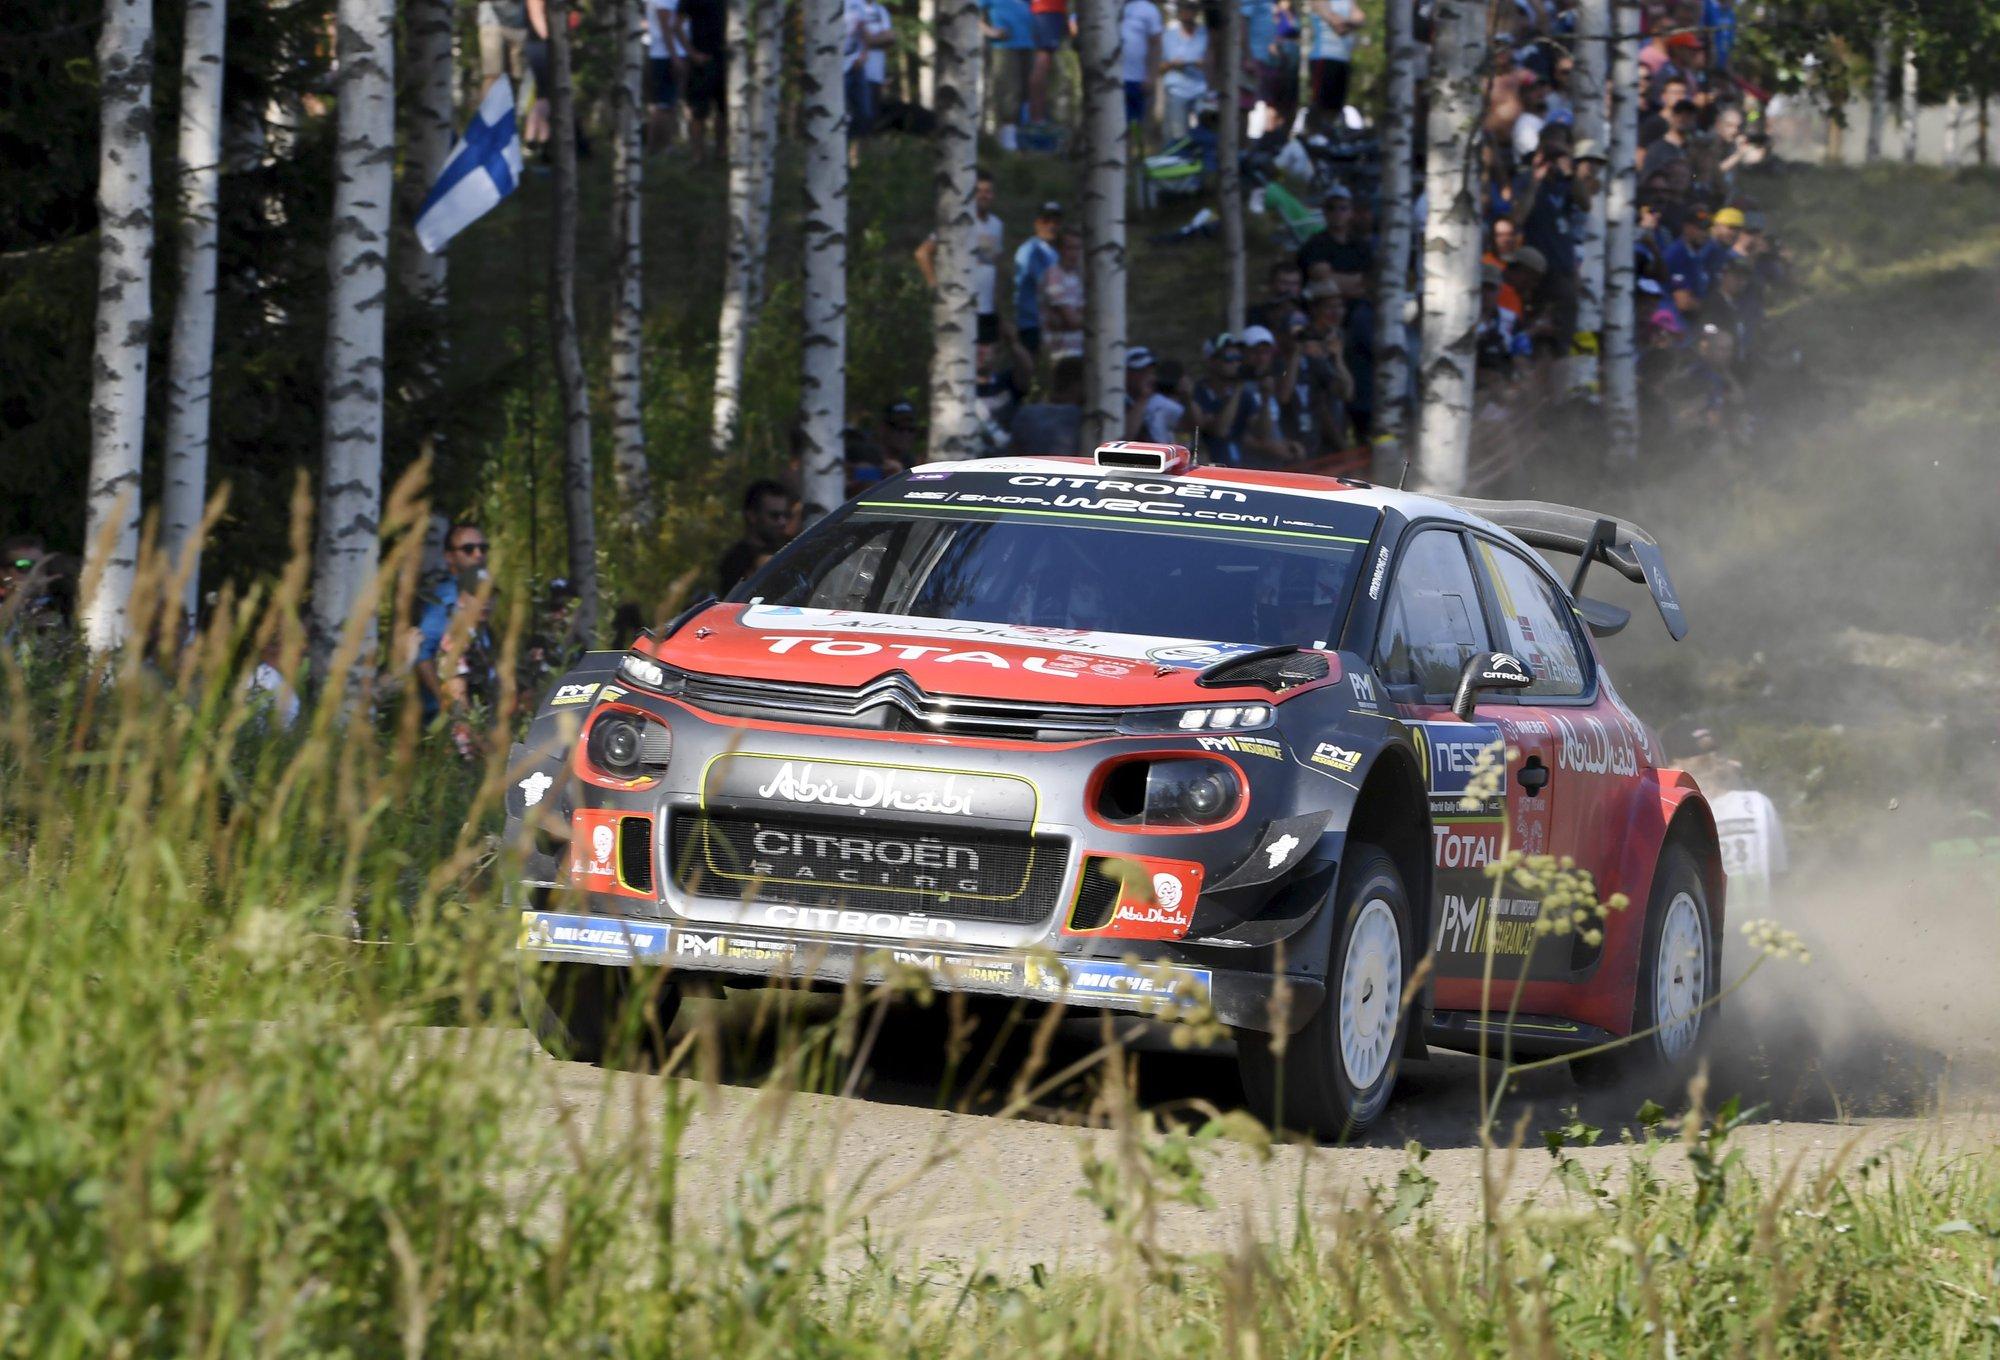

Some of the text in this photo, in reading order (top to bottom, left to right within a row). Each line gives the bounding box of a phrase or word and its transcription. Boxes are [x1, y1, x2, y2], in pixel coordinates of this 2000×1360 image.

[760, 636, 1079, 679] TOTAL
[1482, 670, 1530, 683] CITROËN
[759, 762, 974, 816] Abu Dhabi
[753, 829, 980, 870] CITROËN
[1433, 825, 1501, 868] TOTAL
[764, 904, 957, 938] CITROËN
[1115, 906, 1188, 925] Abu Dhabi
[553, 926, 655, 948] MICHELIN
[1479, 920, 1537, 955] IURANCE
[1077, 973, 1178, 993] MICHEI
